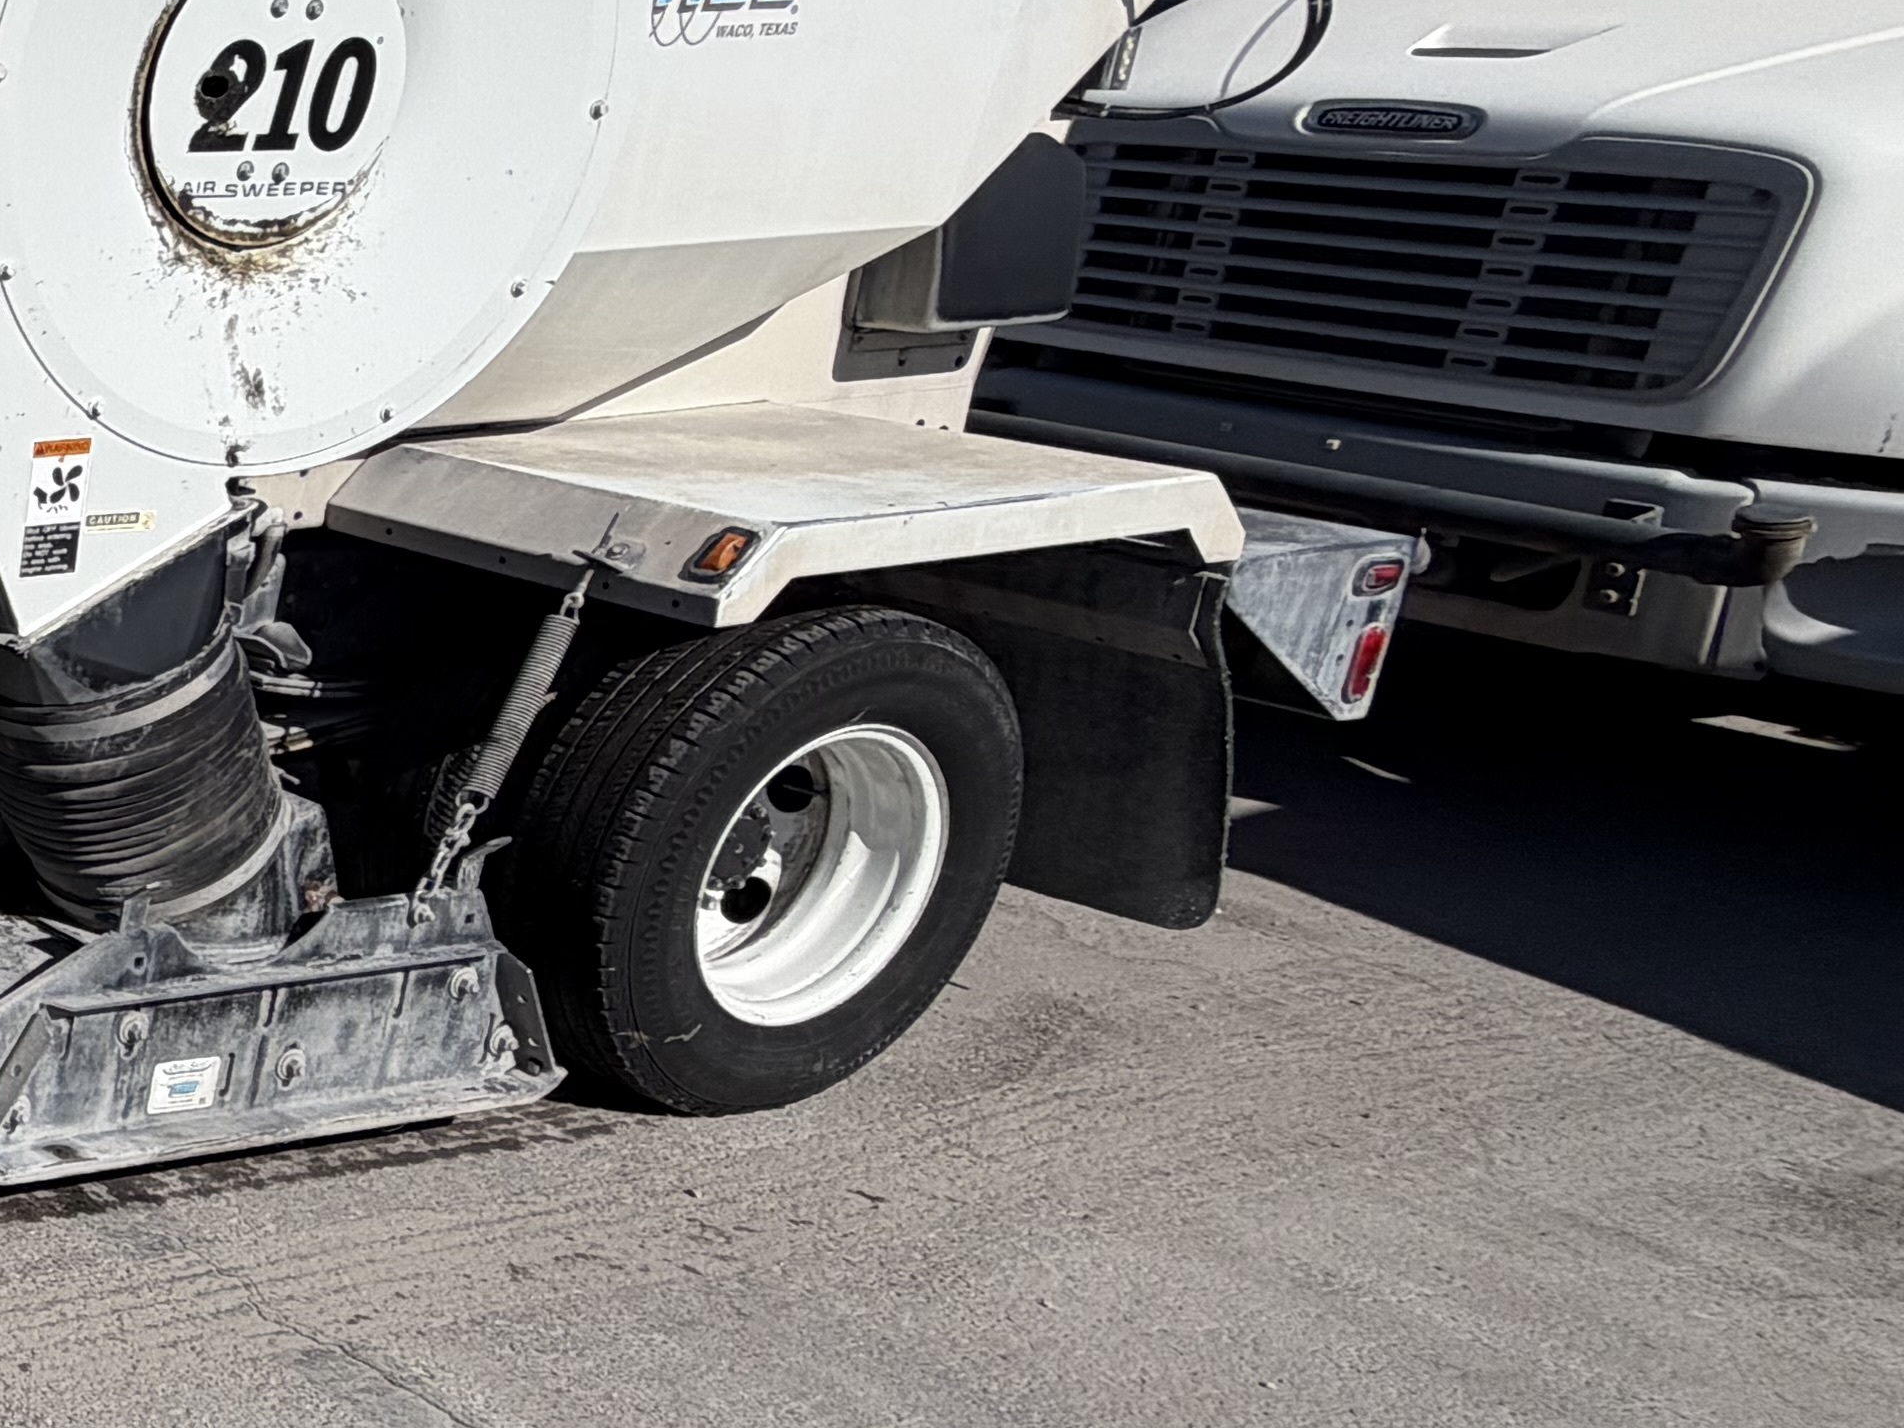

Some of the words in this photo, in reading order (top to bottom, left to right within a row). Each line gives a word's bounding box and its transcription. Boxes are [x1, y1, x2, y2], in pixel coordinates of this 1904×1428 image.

[759, 22, 799, 37] TEXAS
[186, 36, 377, 153] 210
[1321, 110, 1459, 130] FREIGHTLINER
[224, 181, 348, 198] SWEEPER
